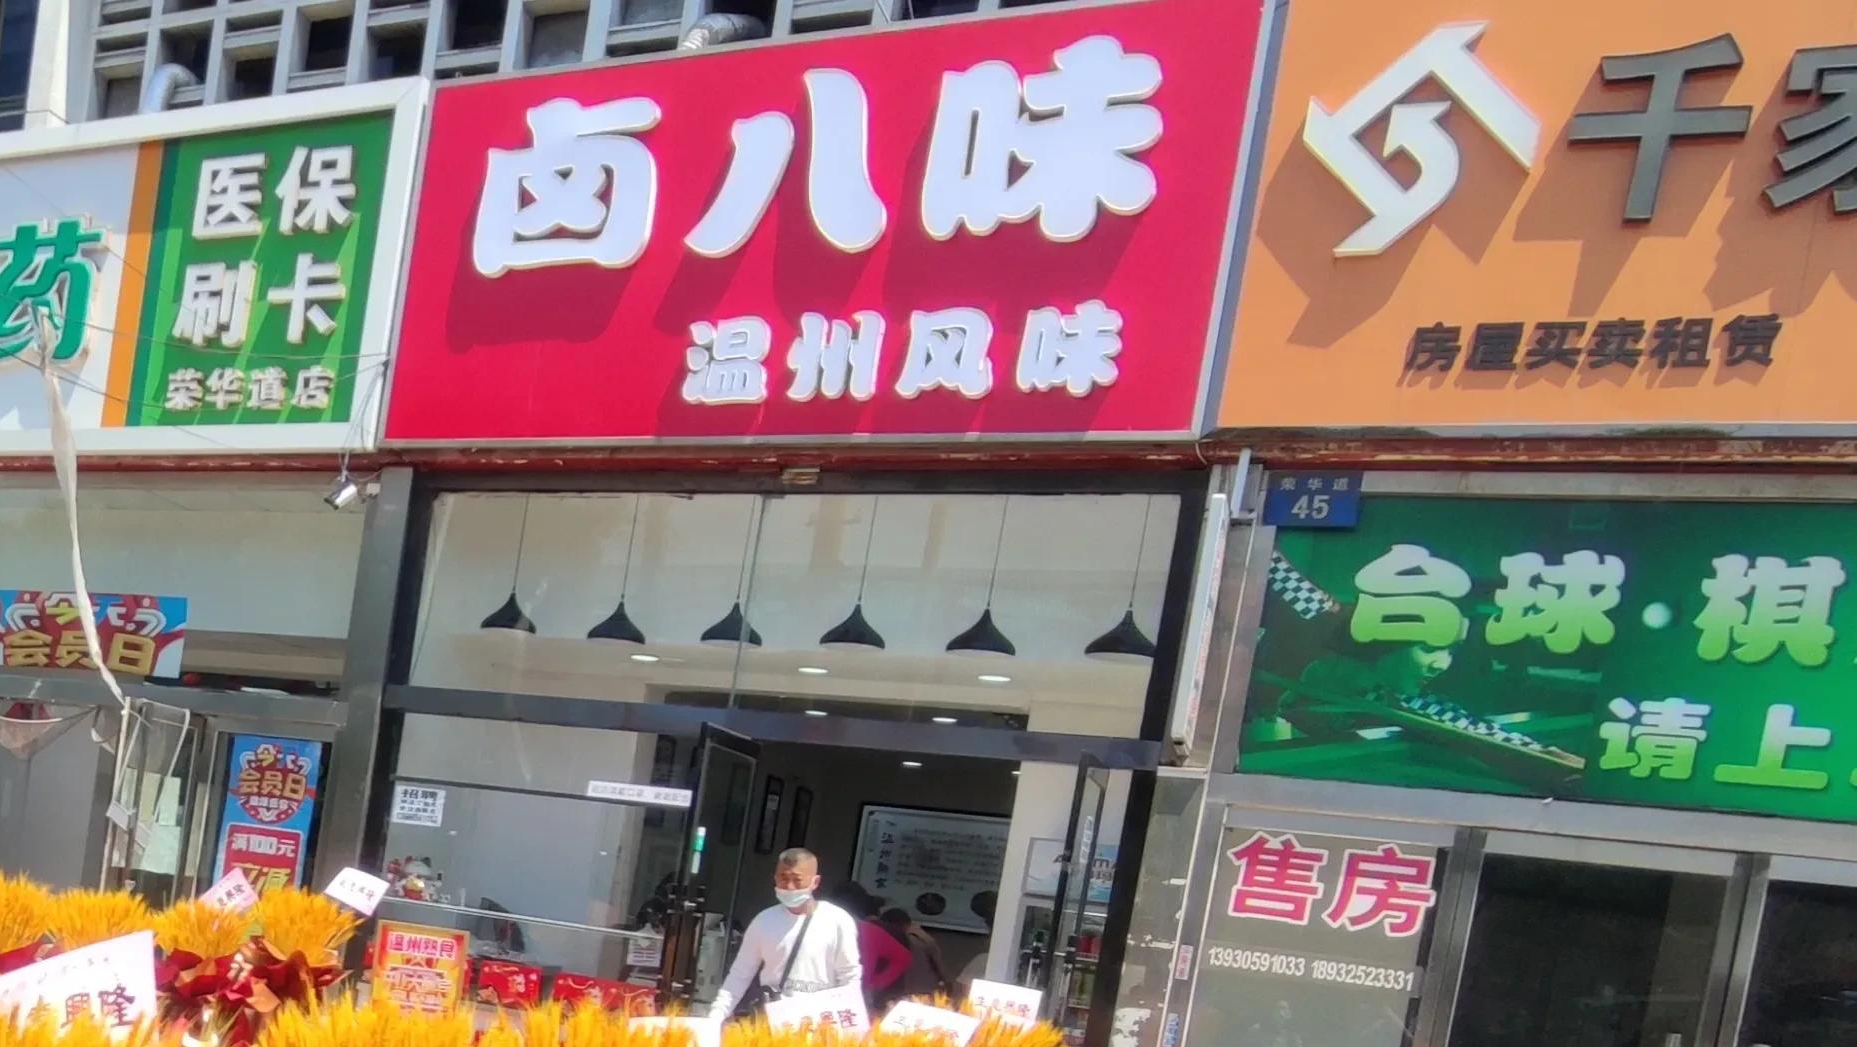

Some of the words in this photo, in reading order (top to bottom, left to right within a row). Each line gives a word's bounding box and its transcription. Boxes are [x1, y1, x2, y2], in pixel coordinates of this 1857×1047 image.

[472, 34, 1164, 278] 卤八味
[192, 144, 357, 240] 医保
[172, 252, 347, 348] 刷卡
[681, 299, 1124, 406] 温州风味
[1405, 312, 1784, 373] 房屋买卖租赁
[164, 364, 335, 411] 荣华道店
[1280, 477, 1349, 491] 荣华道
[1291, 494, 1330, 519] 45
[1350, 543, 1857, 668] 台球·棋
[3, 628, 157, 676] 会员日
[1598, 696, 1857, 791] 请上
[238, 768, 309, 801] 会员日
[1227, 831, 1436, 937] 售房
[389, 932, 456, 959] 温州熟食
[1208, 946, 1305, 977] 13930591033
[1311, 959, 1414, 991] 18932523331
